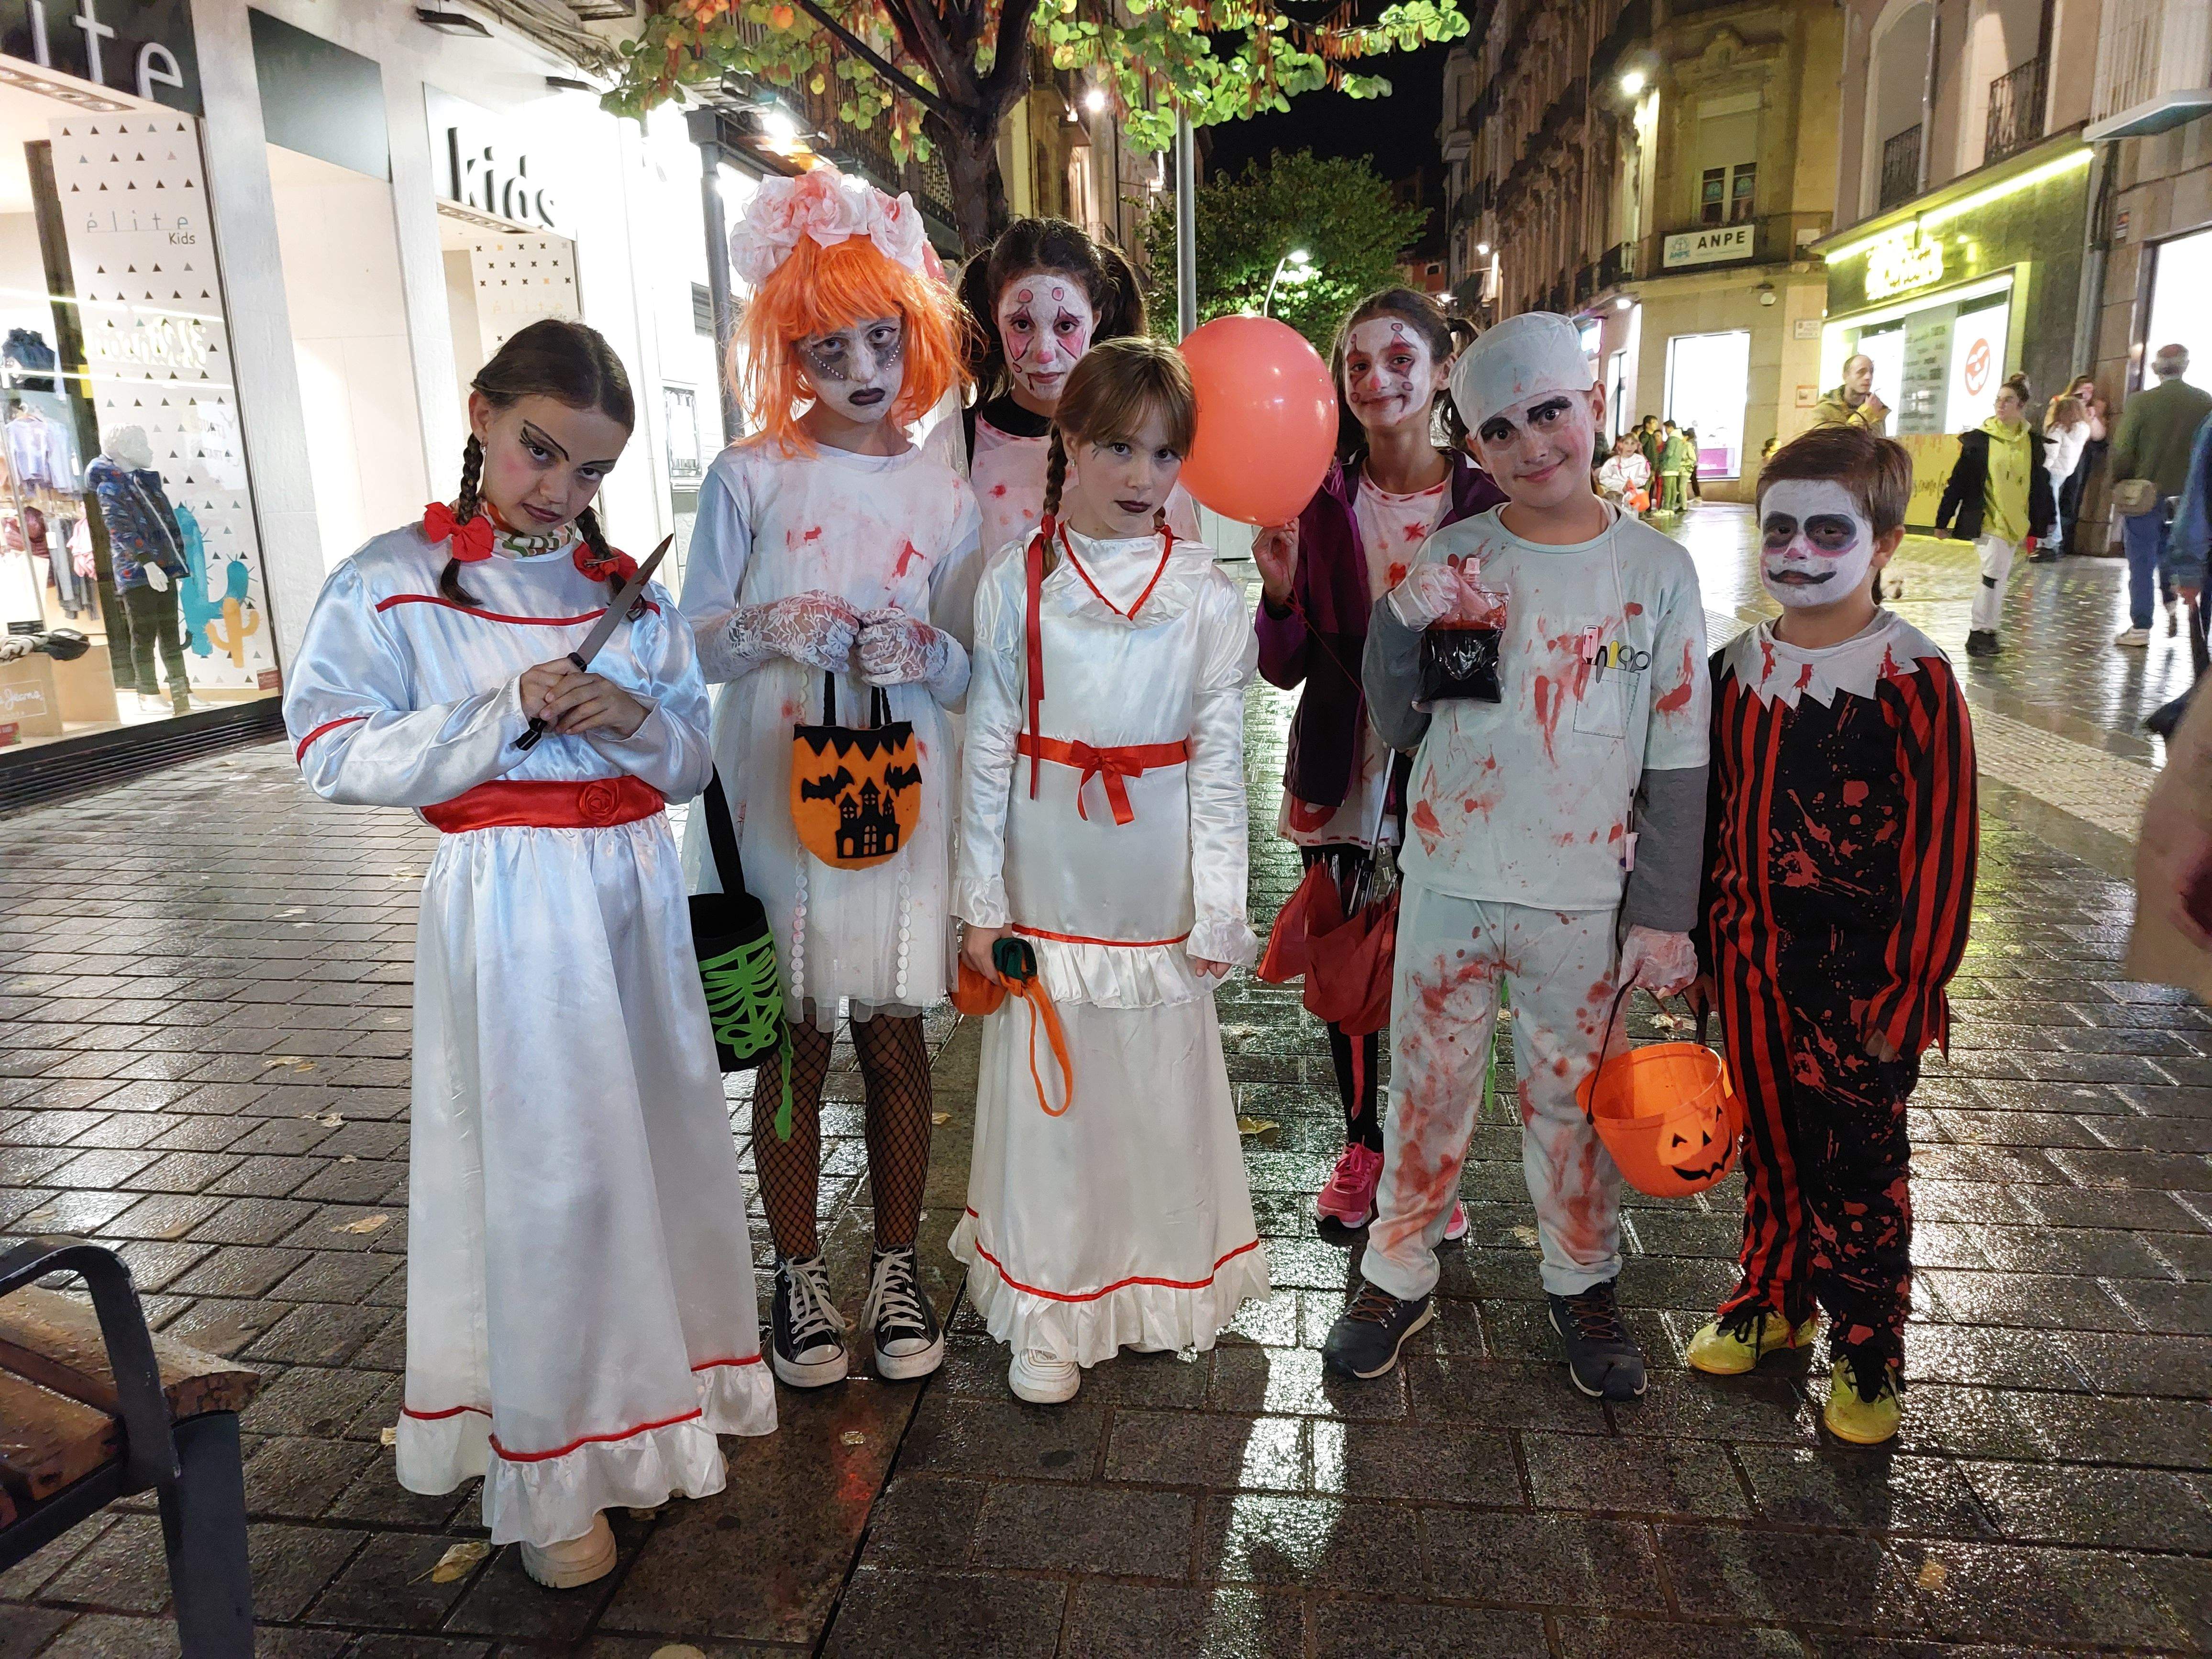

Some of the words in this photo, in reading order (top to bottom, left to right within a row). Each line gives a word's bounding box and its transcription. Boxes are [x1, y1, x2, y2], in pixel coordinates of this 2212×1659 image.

[446, 126, 557, 229] kids
[87, 210, 188, 233] élite
[169, 232, 195, 244] Kids
[1697, 231, 1745, 249] ANPE
